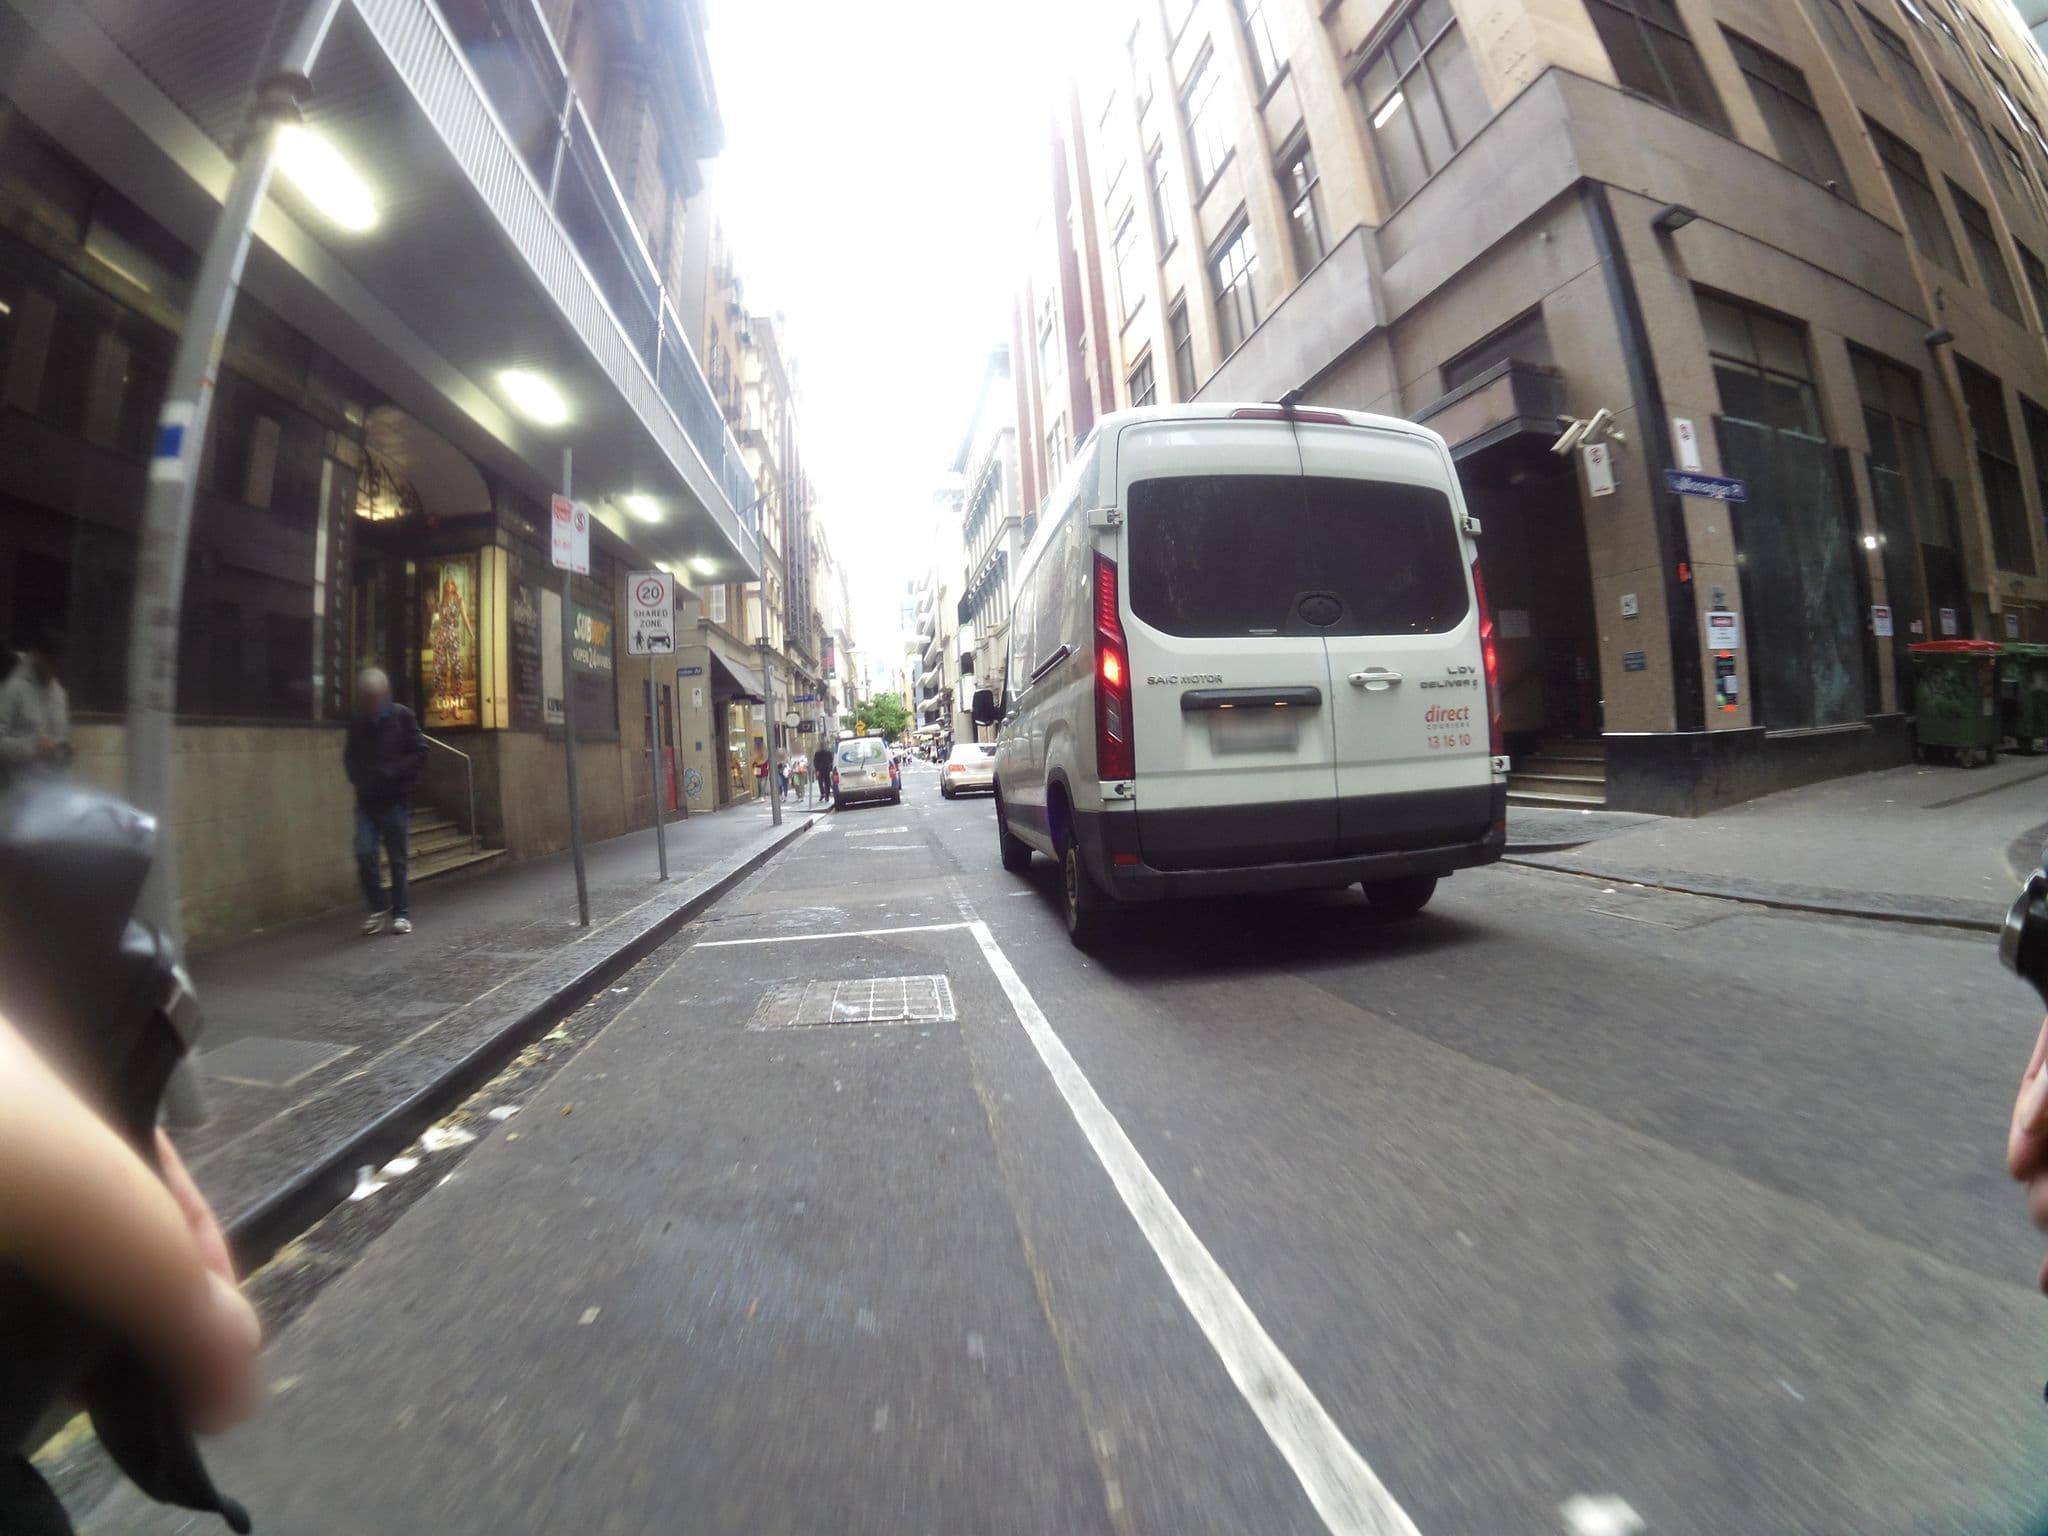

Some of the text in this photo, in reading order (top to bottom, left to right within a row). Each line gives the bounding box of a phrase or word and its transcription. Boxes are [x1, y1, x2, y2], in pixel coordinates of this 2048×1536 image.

[642, 586, 660, 599] 20
[633, 609, 668, 618] SHARED
[640, 620, 662, 628] ZONE
[1447, 666, 1476, 675] LDV
[1147, 674, 1223, 685] SAIC MOTOR
[1420, 680, 1470, 689] DELIVER
[1425, 704, 1470, 723] direct
[1428, 733, 1472, 749] 13 16 10
